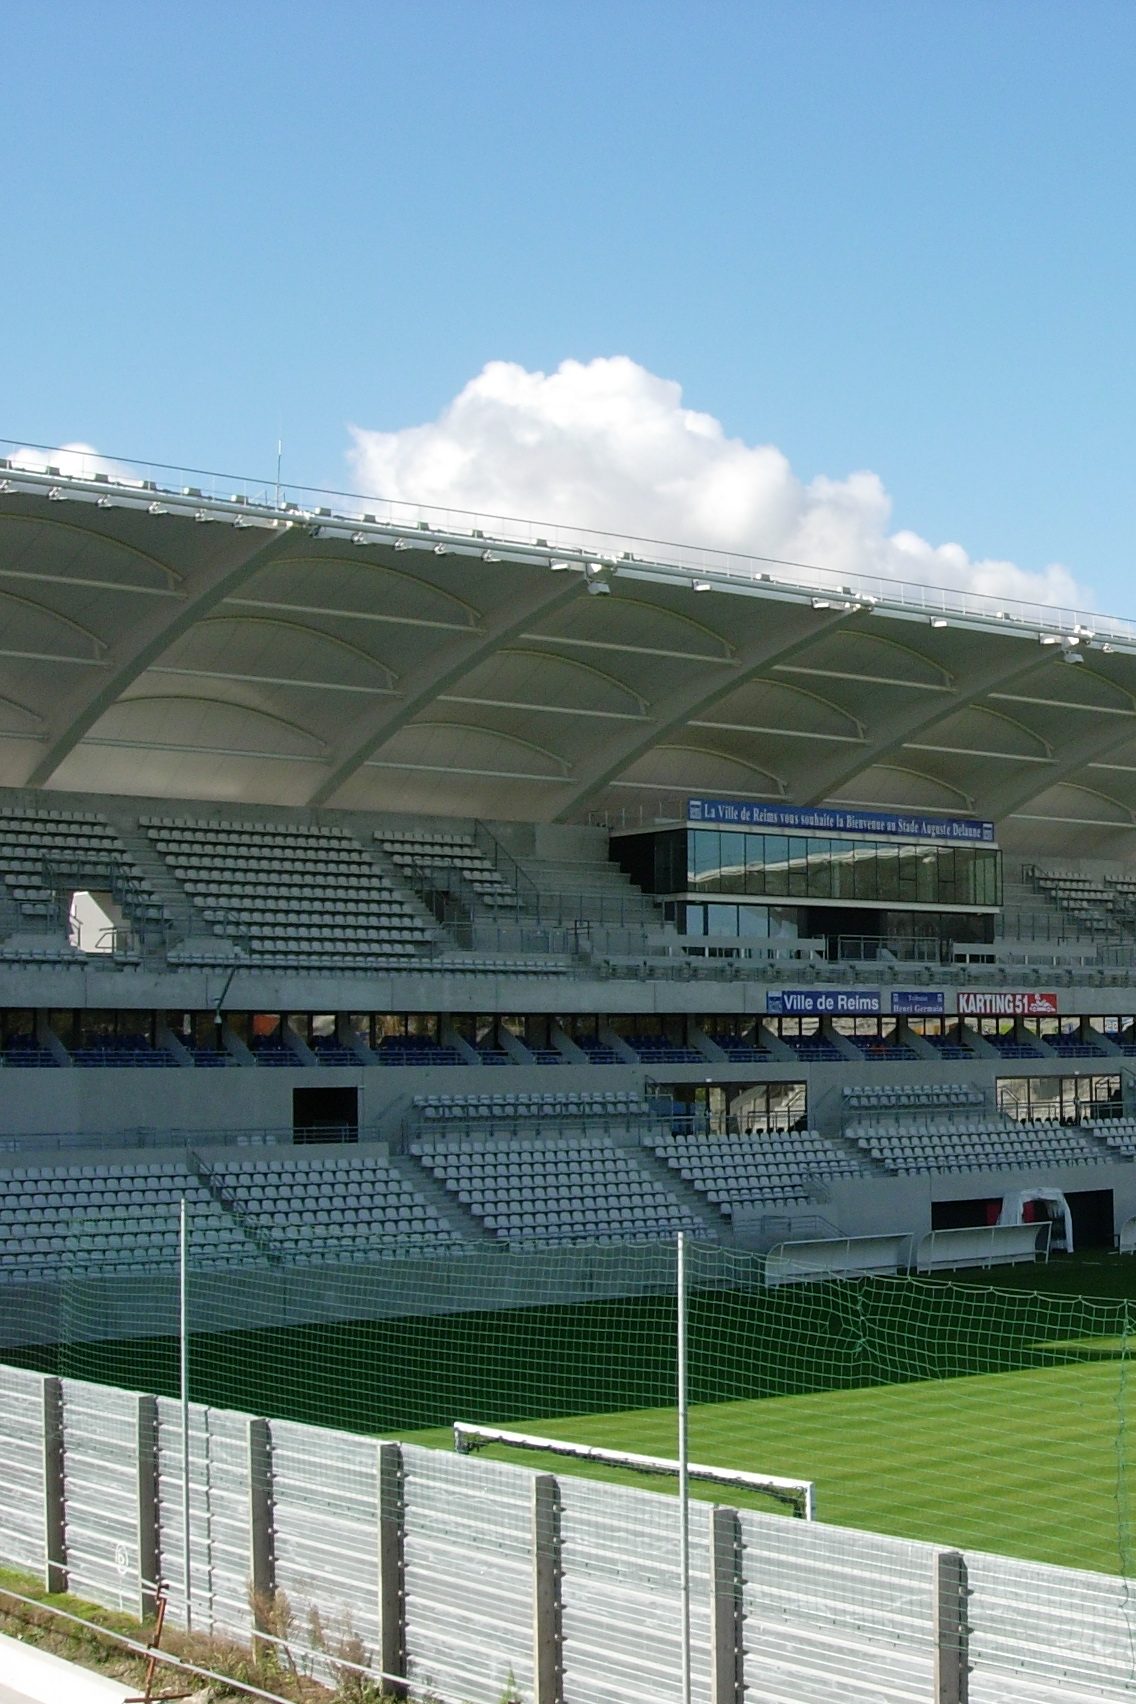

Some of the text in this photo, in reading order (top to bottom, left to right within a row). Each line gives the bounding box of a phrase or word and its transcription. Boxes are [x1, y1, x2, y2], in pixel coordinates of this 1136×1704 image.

[704, 804, 981, 838] La Ville de Reims vous souhaite la Bienvenue au Stade Auguste Delaune
[784, 994, 879, 1010] Ville de Reims
[893, 1004, 943, 1013] Henri Germain
[959, 994, 1029, 1013] KARTING 51
